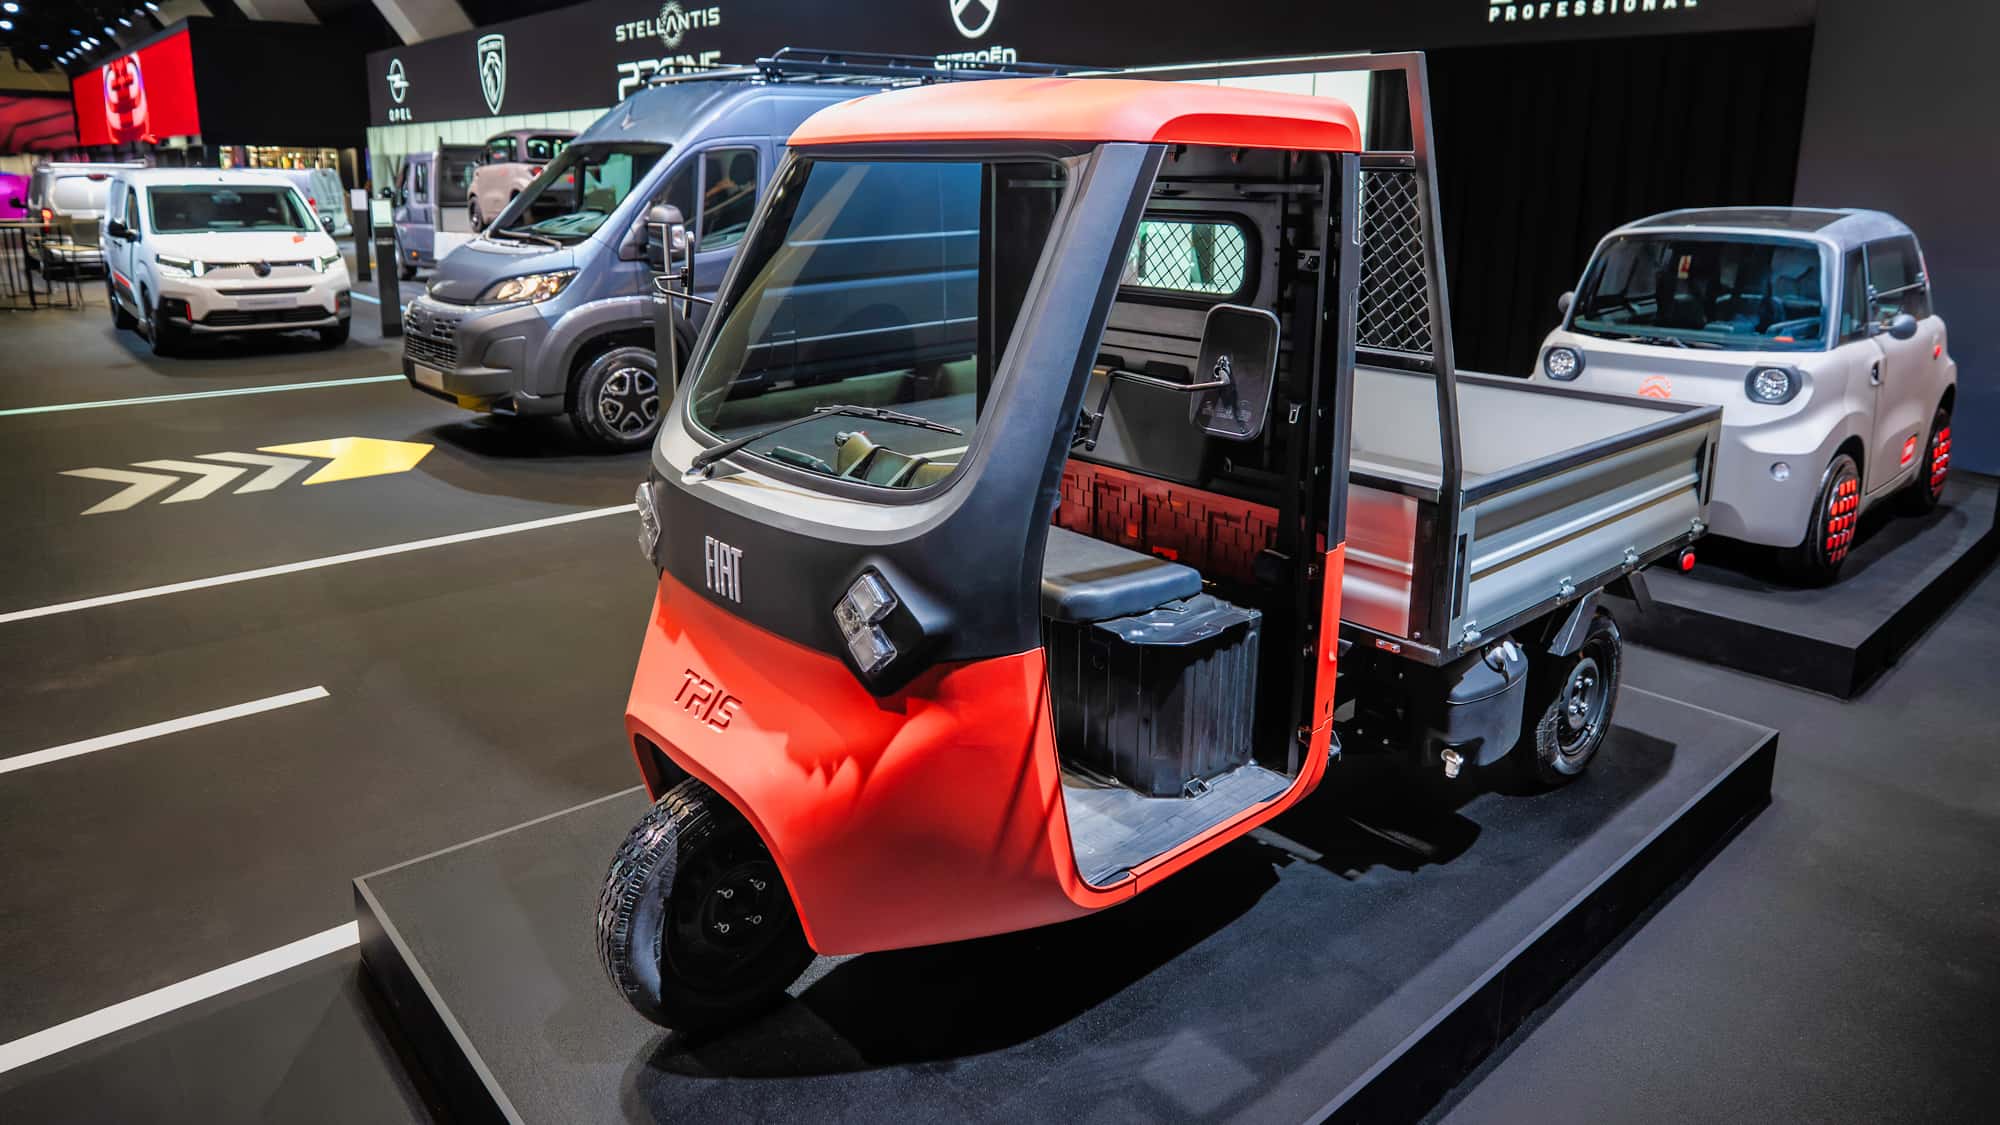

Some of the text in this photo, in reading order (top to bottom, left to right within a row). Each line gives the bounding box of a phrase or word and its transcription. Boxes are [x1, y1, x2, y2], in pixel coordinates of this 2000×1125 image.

[616, 7, 720, 42] STELLANTIS
[704, 535, 743, 603] FIAT
[673, 668, 743, 734] TRIS
